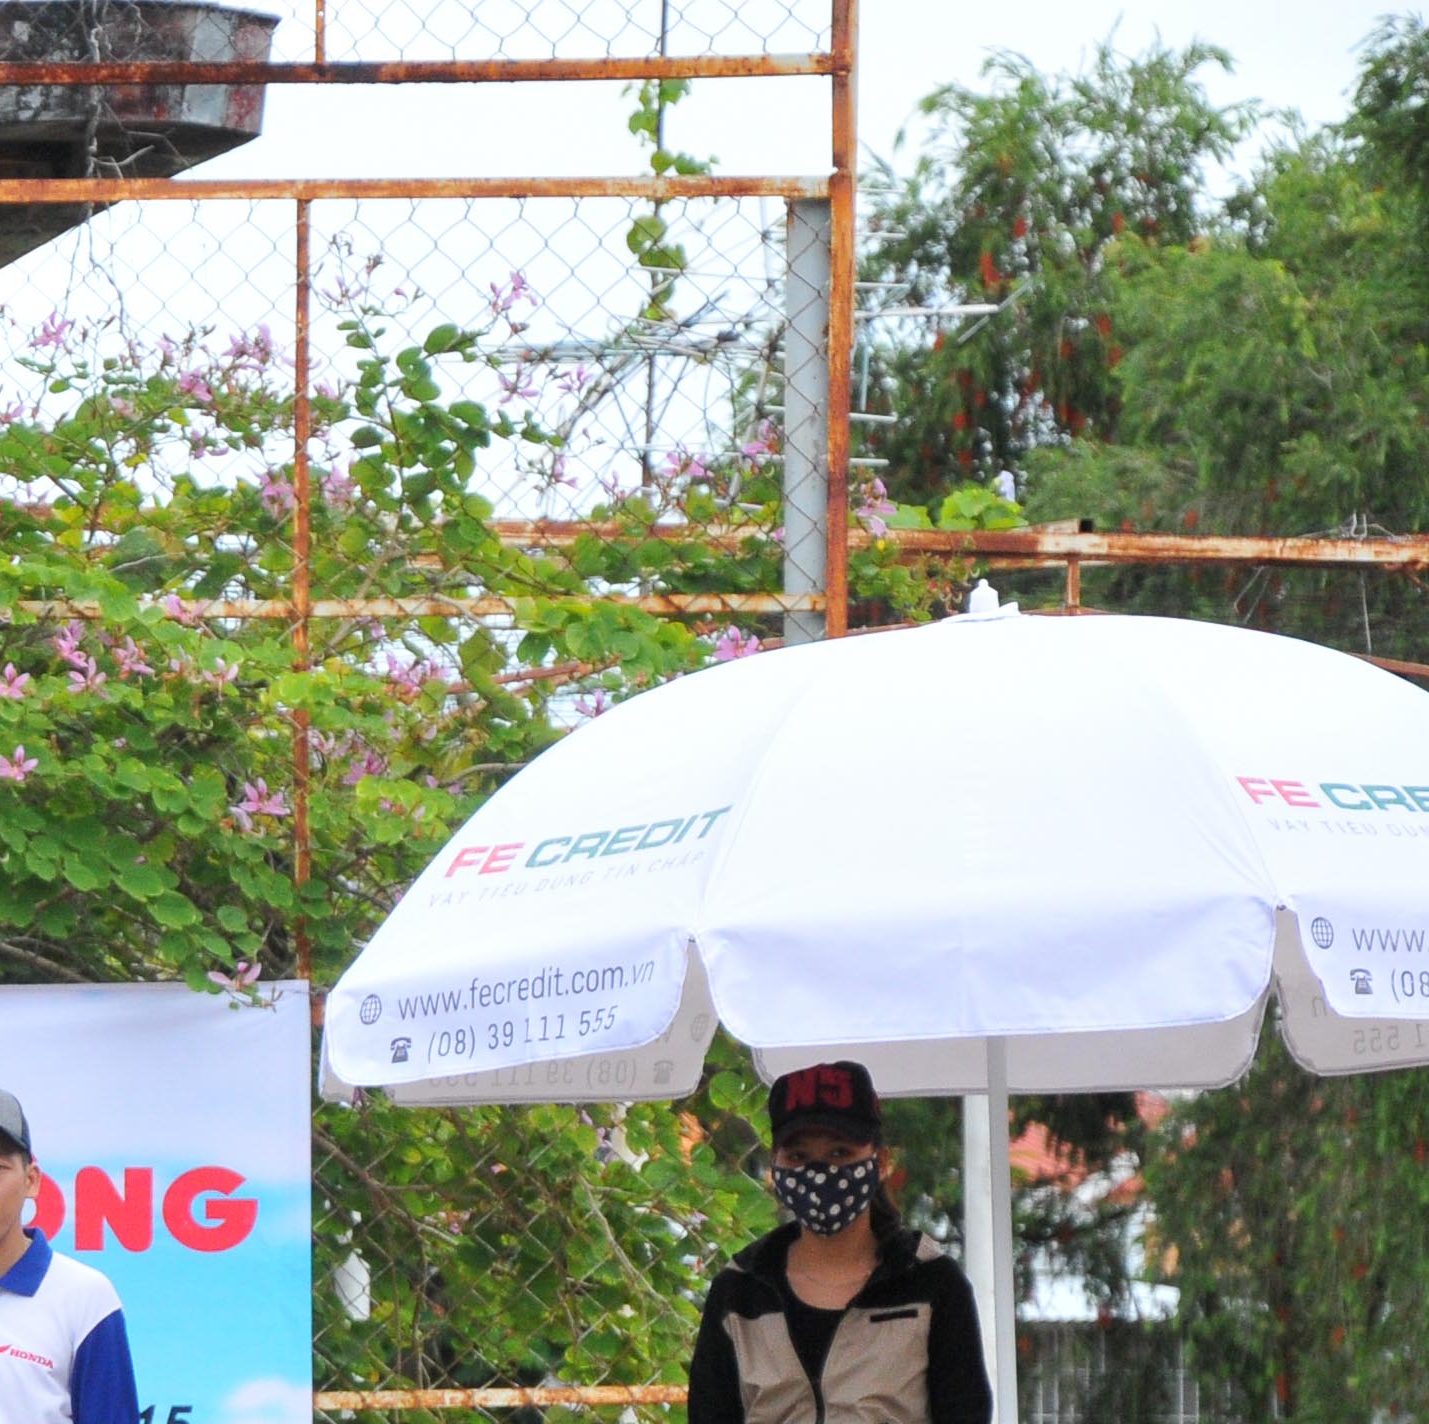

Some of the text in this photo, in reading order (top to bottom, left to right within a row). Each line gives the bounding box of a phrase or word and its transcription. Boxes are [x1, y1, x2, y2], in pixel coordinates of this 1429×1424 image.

[1235, 776, 1322, 808] FE
[444, 804, 734, 878] FE CREDIT
[398, 960, 655, 1021] www.fecredit.com.vn
[427, 1025, 476, 1064] (08)
[487, 1020, 514, 1050] 39
[523, 1013, 566, 1044] 111
[578, 1004, 619, 1037] 555
[10, 1348, 54, 1369] HONDA
